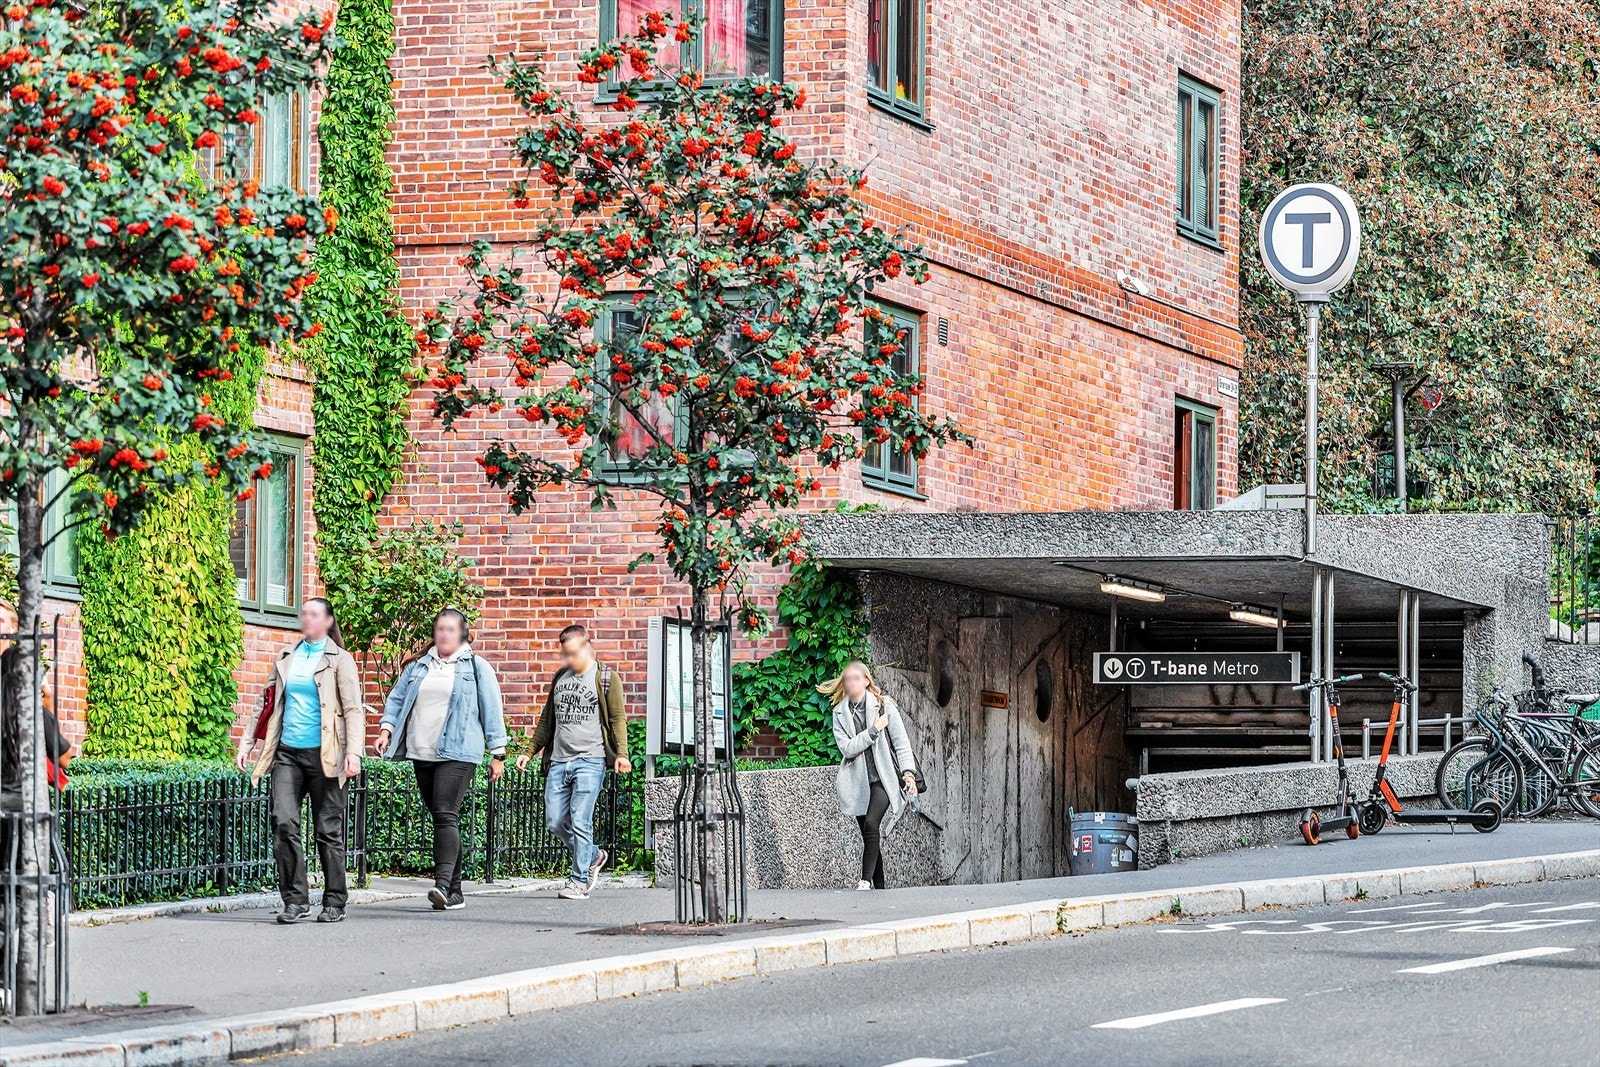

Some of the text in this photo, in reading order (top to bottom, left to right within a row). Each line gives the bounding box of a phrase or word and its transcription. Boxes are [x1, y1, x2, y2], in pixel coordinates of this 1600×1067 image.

[1285, 212, 1331, 269] T
[1130, 660, 1259, 676] T T-bane Metro
[1346, 901, 1600, 914] AXI
